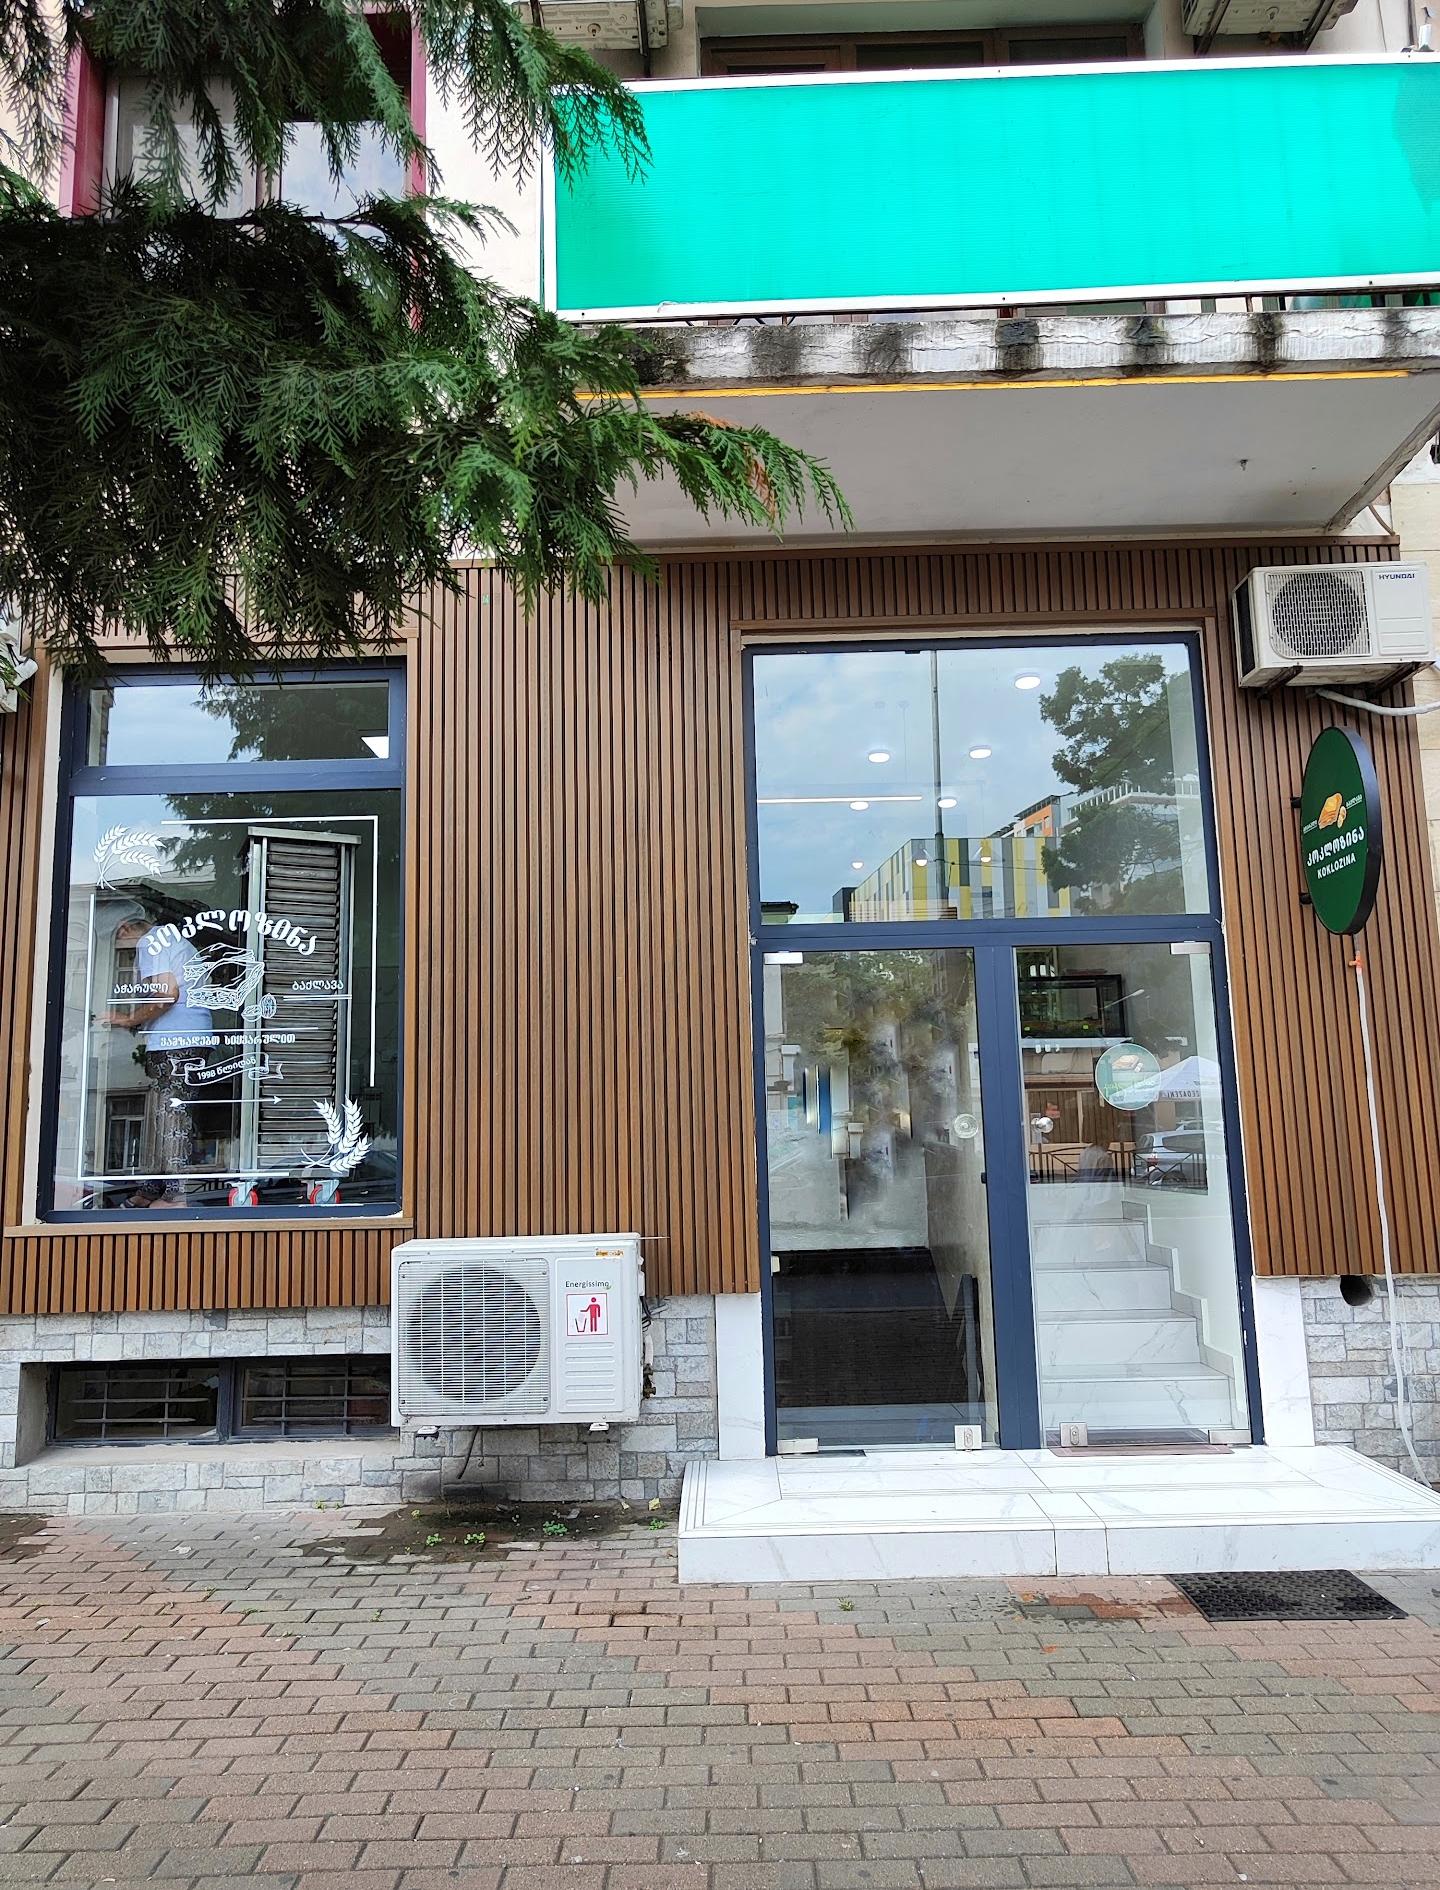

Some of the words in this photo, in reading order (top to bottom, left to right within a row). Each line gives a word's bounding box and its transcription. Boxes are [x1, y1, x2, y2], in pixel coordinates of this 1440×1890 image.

[1306, 825, 1365, 867] კოკლოზინა
[1317, 852, 1357, 880] KOKLOZINA
[146, 909, 318, 956] კოკლოზინა
[113, 982, 169, 994] აჭარული
[292, 979, 344, 991] ბაქლავა
[160, 1035, 220, 1047] ვამზადებთ
[224, 1033, 296, 1046] სიყვარულით
[197, 1070, 216, 1080] 1998
[216, 1056, 257, 1075] წლიდან
[565, 1280, 610, 1289] Energissimo
